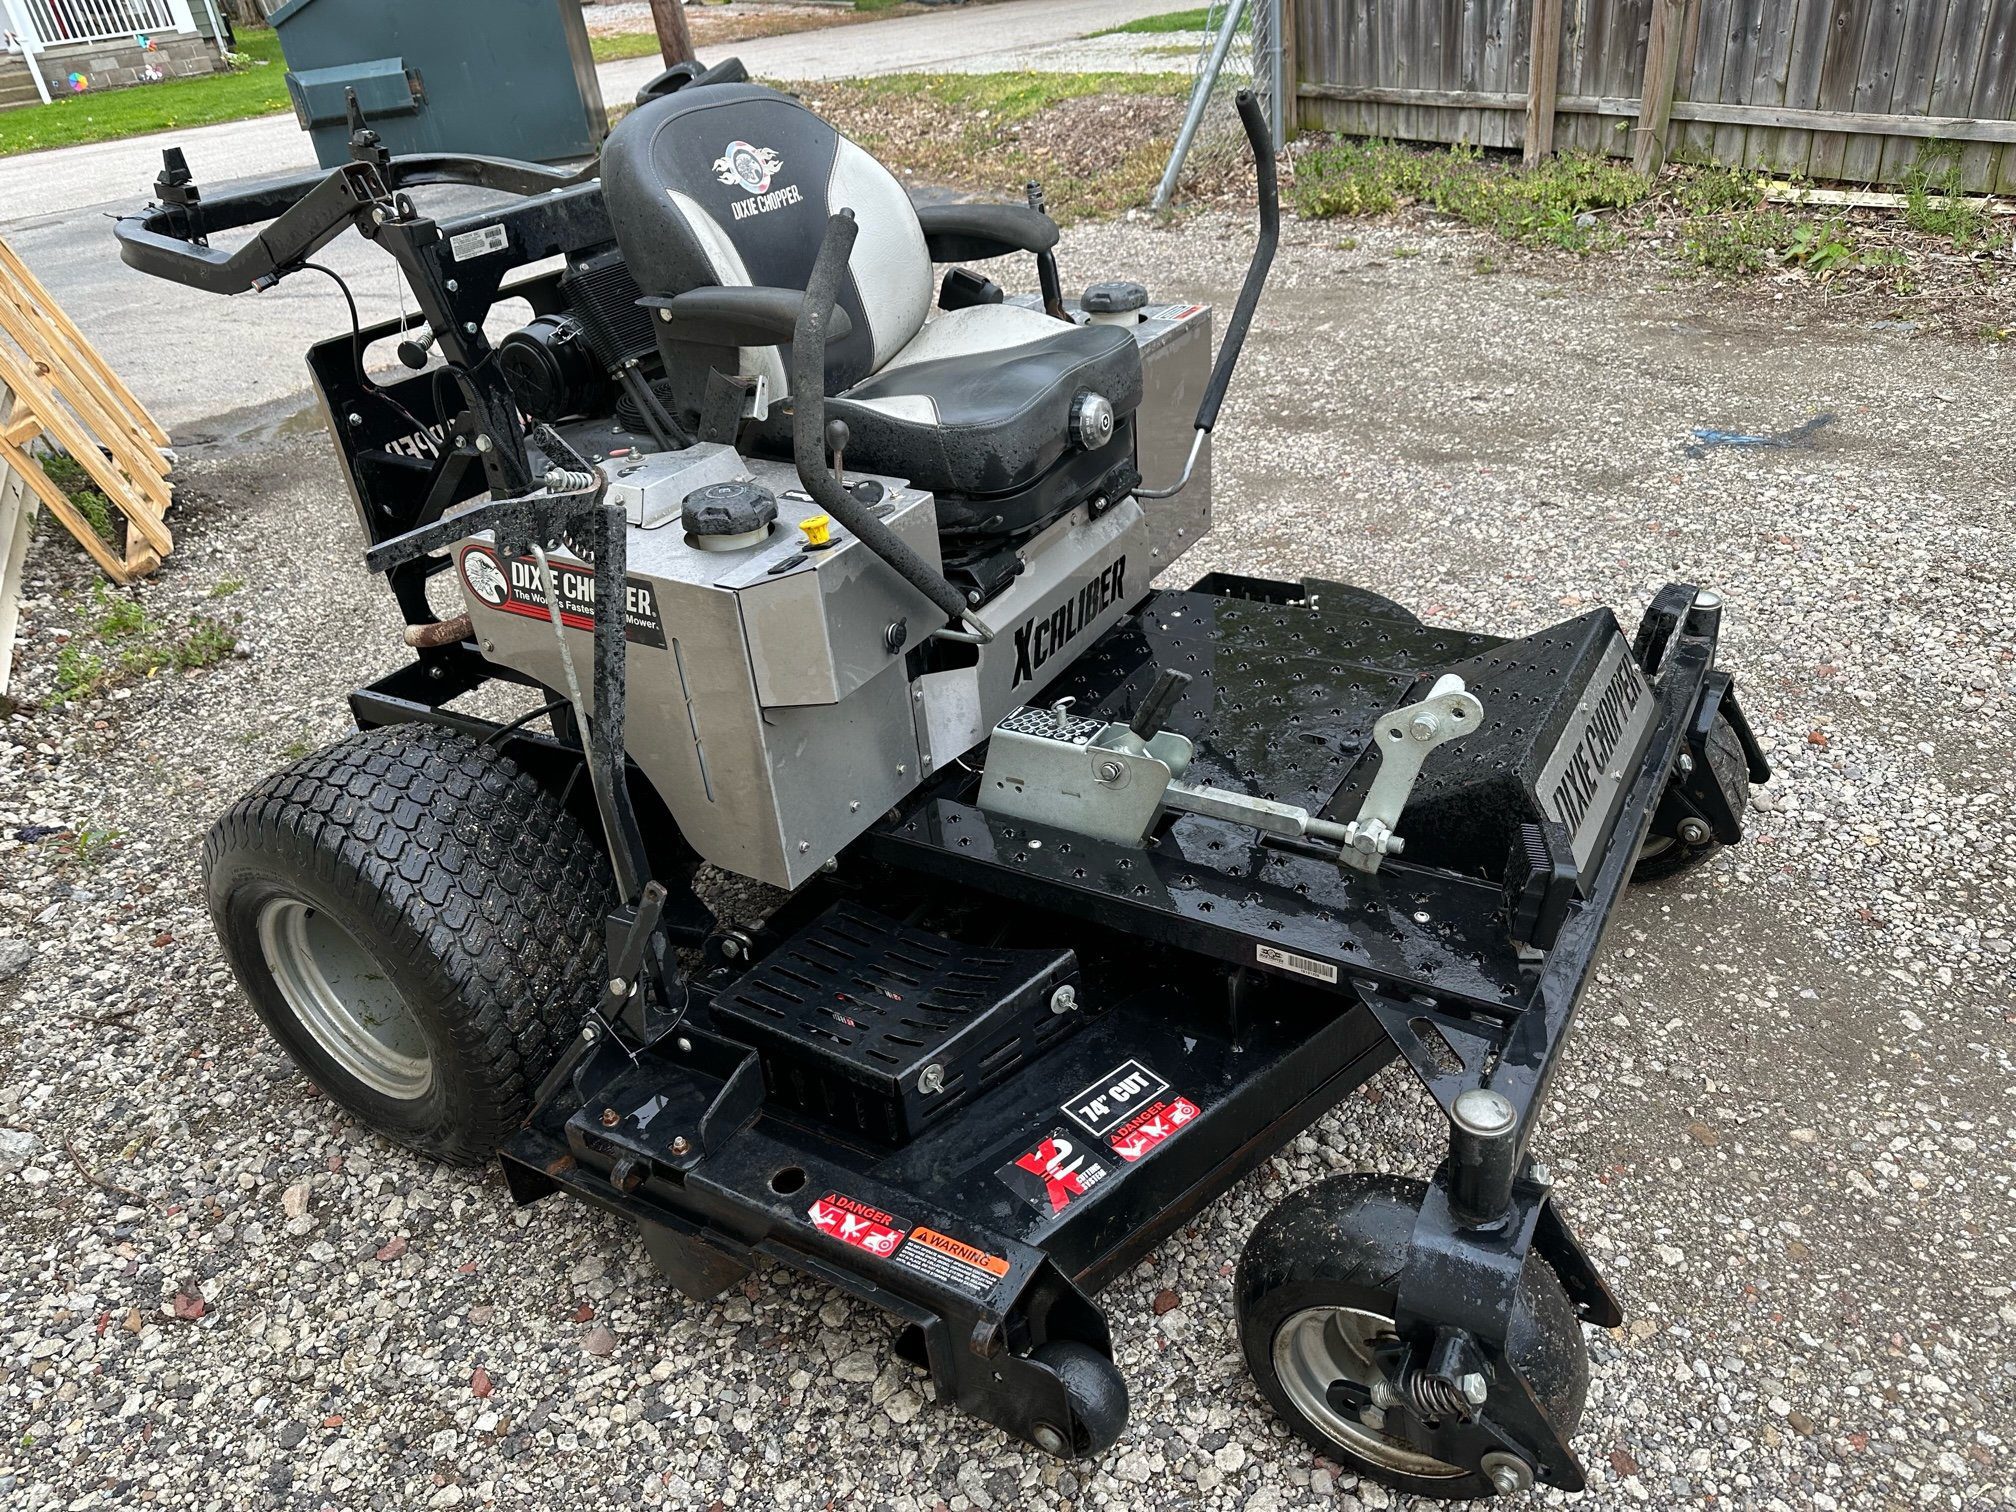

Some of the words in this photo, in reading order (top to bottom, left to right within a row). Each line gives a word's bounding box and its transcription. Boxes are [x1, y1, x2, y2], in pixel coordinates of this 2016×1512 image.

[731, 198, 759, 220] DIXIE
[757, 184, 801, 213] CHOPPER
[511, 561, 560, 596] DIXE
[563, 572, 651, 616] CHER
[513, 588, 531, 601] The
[565, 600, 596, 616] Fastes
[1011, 553, 1127, 691] XCALIBER
[1552, 740, 1599, 847] DIXIE
[1584, 652, 1643, 776] CHOPPER
[1108, 1071, 1150, 1102] CUT
[1118, 1100, 1167, 1138] DANGER
[1075, 1161, 1102, 1184] CUTTING
[1080, 1168, 1108, 1191] SYSTEM
[836, 1197, 893, 1226] DANGER
[930, 1232, 990, 1266] WARNING
